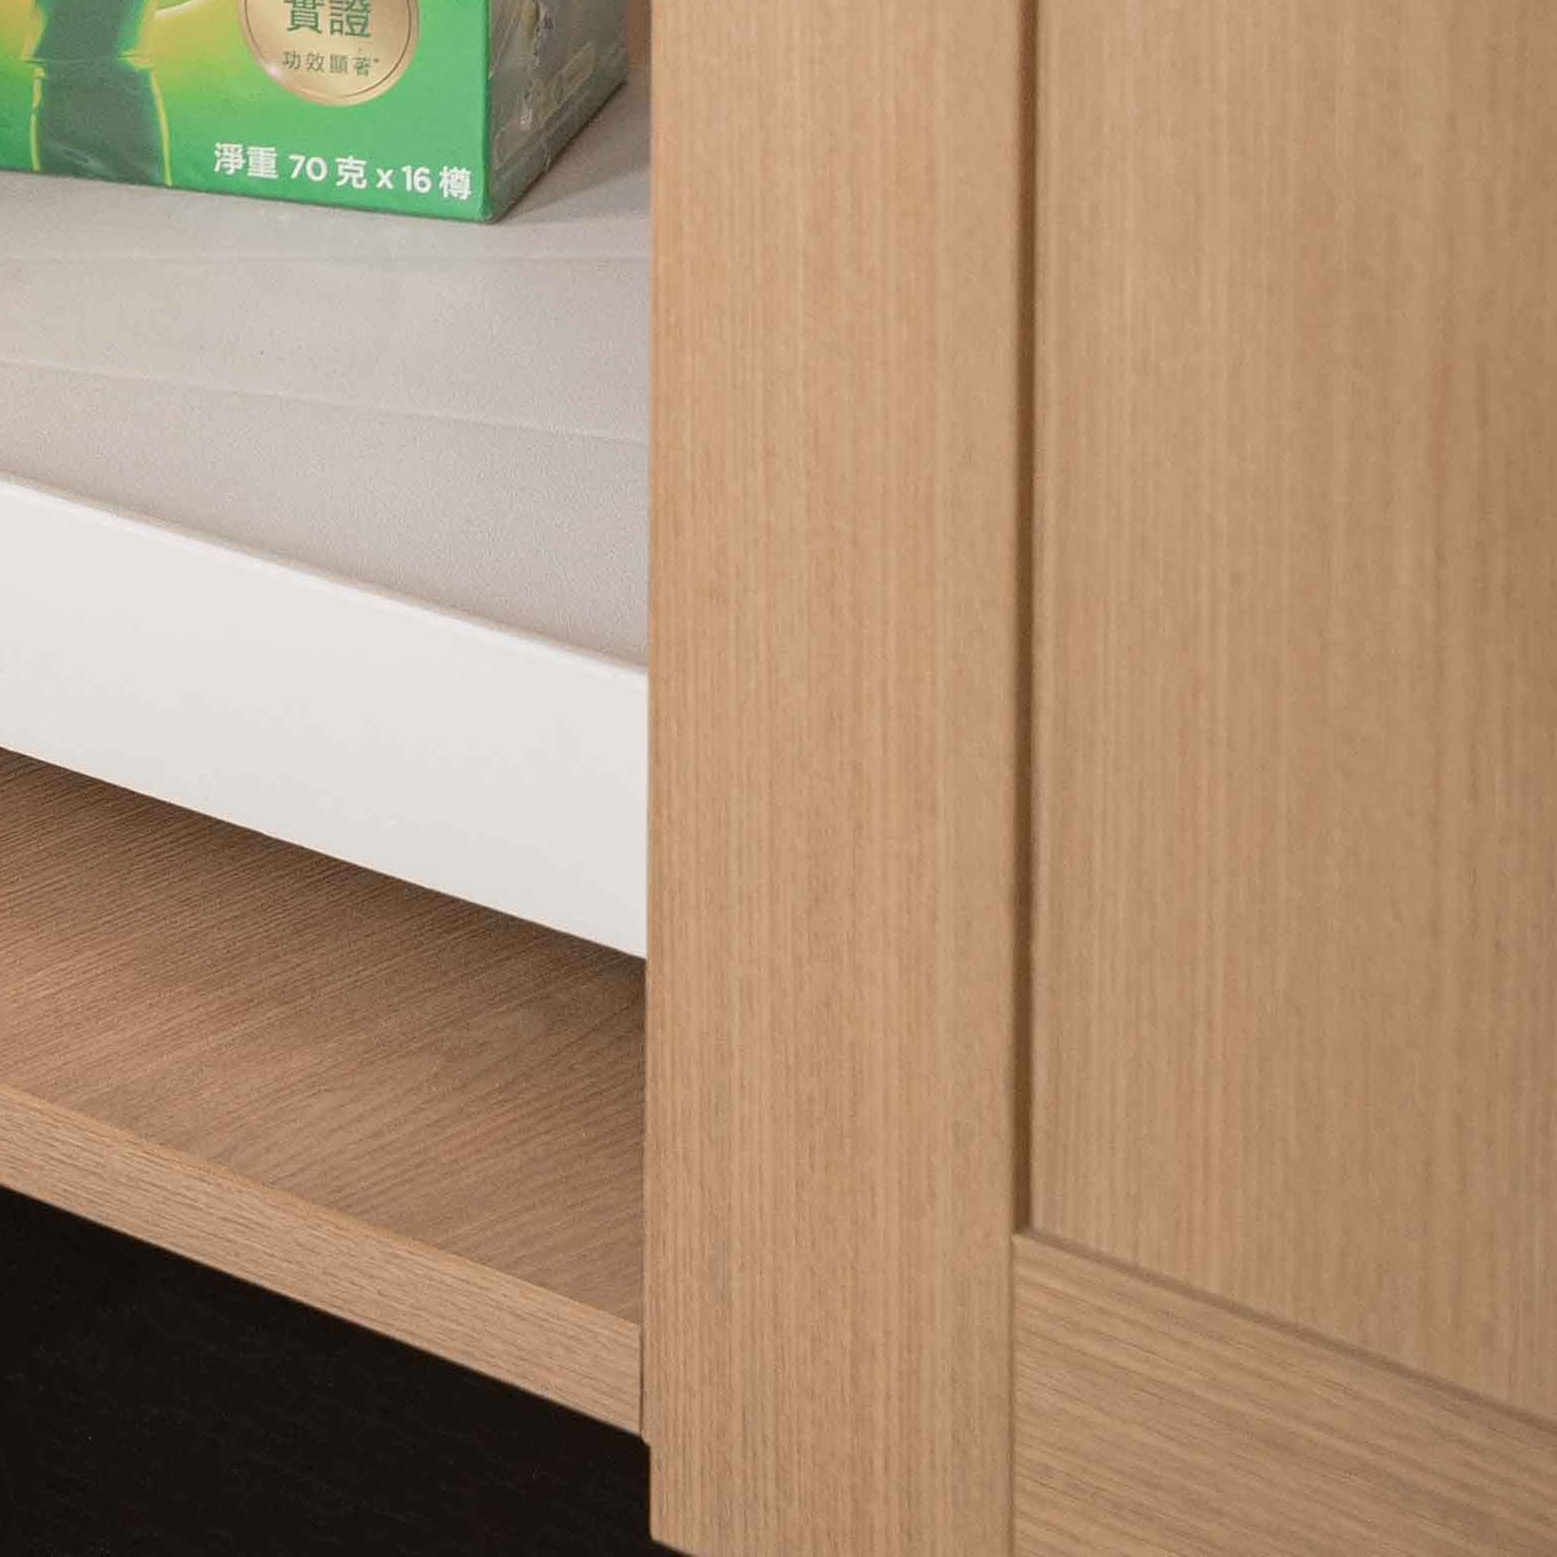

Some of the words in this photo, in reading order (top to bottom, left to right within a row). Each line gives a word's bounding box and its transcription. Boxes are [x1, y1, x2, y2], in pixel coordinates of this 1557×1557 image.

[213, 141, 279, 180] 淨重
[287, 152, 329, 183] 70
[334, 155, 368, 191] 克
[375, 167, 395, 191] x
[400, 164, 433, 195] 16
